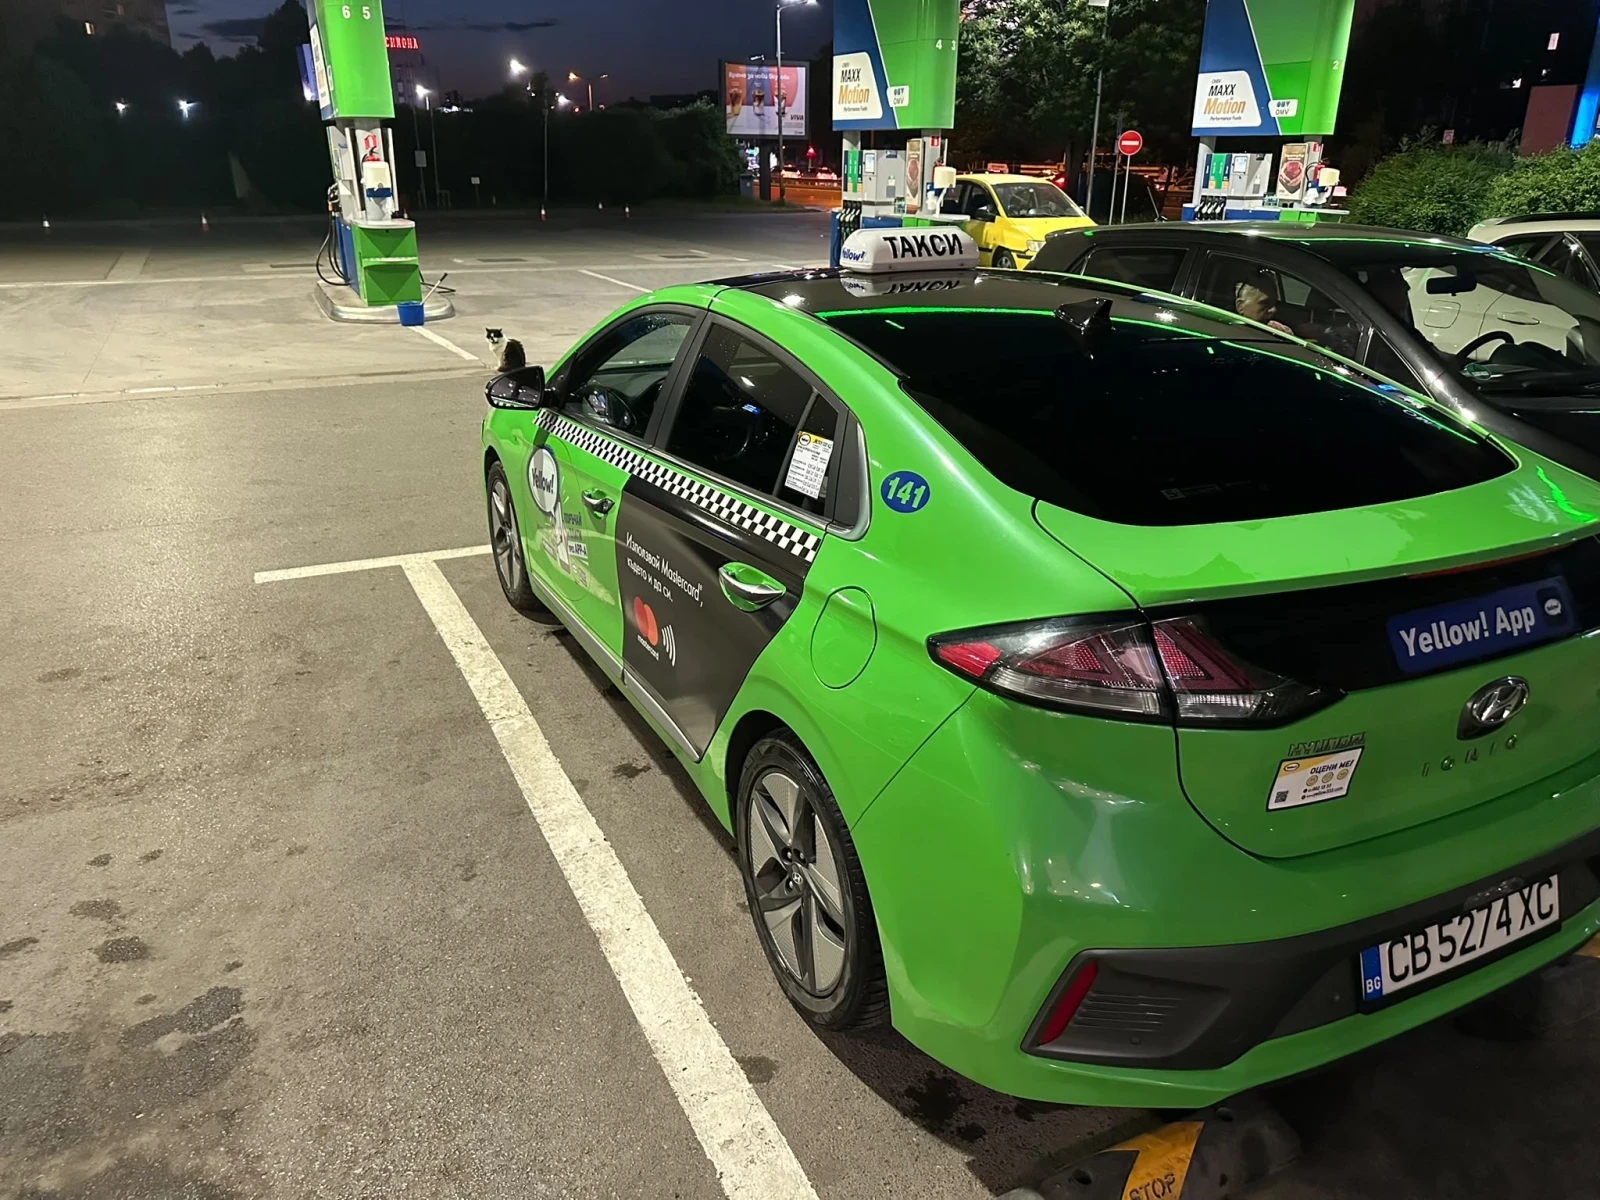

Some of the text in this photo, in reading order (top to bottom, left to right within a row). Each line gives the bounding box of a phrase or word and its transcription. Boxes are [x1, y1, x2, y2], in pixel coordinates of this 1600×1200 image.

[342, 5, 371, 20] 6 5
[935, 39, 957, 51] 4 3
[1332, 60, 1340, 70] 2
[840, 68, 862, 83] MAXX
[838, 84, 870, 105] Motion
[1208, 84, 1237, 97] MAXX
[893, 97, 905, 105] OMV
[1203, 97, 1246, 115] Motion
[882, 233, 964, 260] ТАКСИ
[532, 467, 555, 495] Yellow!
[887, 476, 926, 509] 141
[626, 531, 661, 571] Използвай
[648, 573, 653, 585] и
[653, 578, 662, 593] да
[1400, 606, 1536, 657] Yellow! App
[1310, 762, 1338, 775] ОЦЕНИ
[1338, 759, 1355, 770] МЕ!
[1437, 897, 1512, 964] 5274
[1366, 976, 1381, 993] BG
